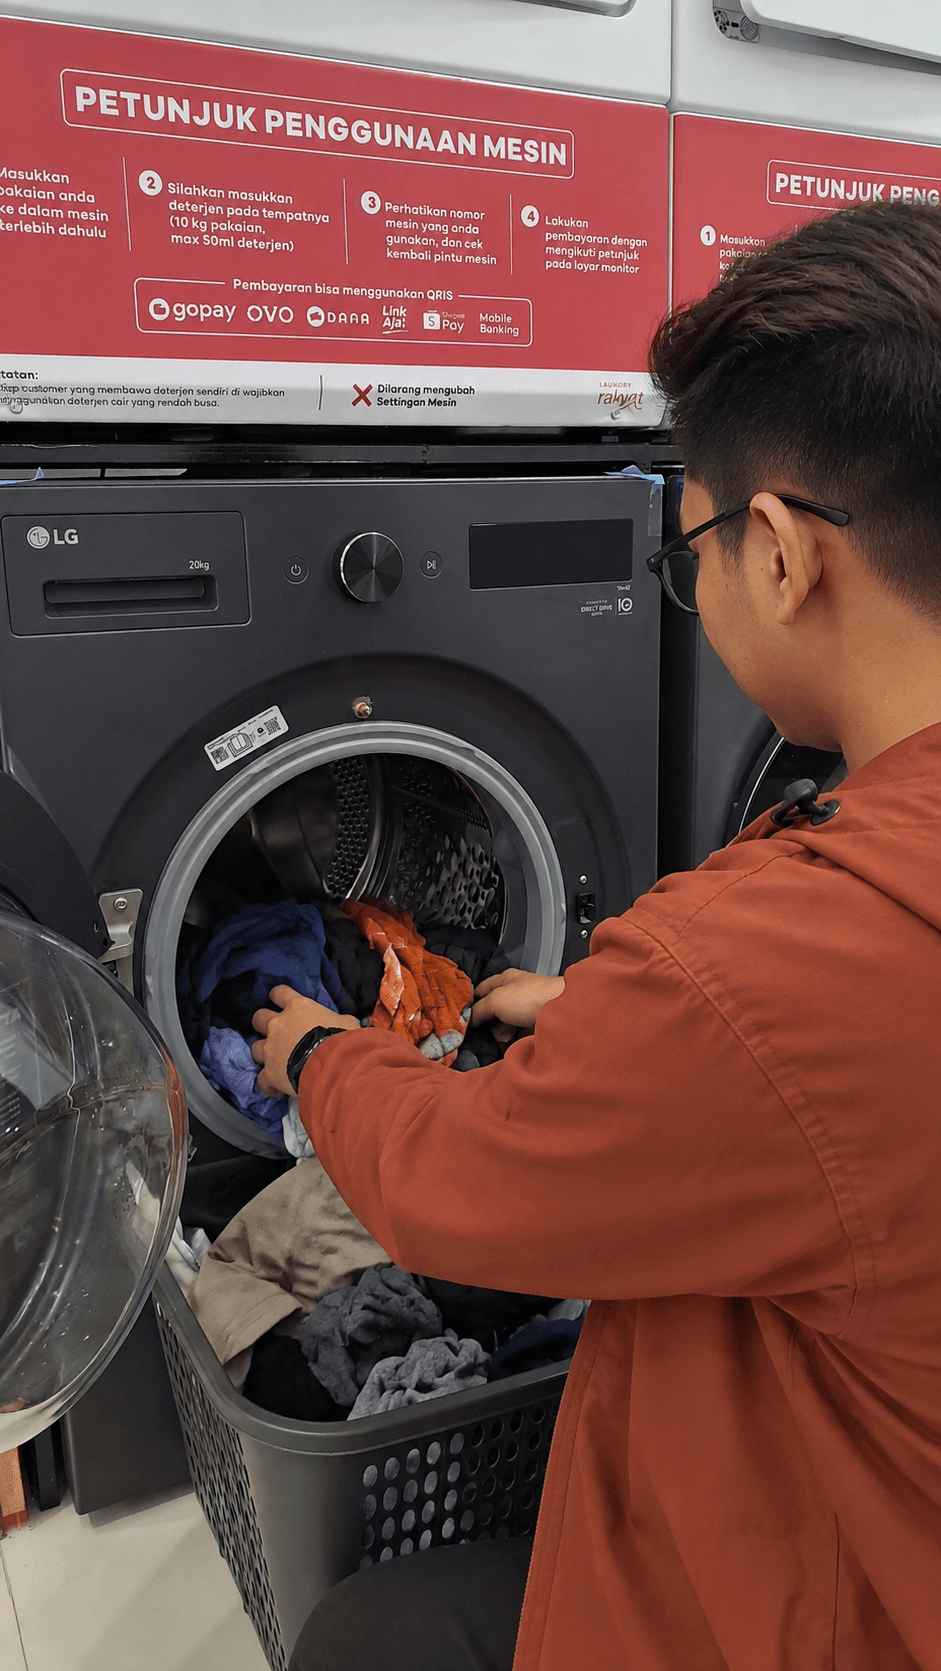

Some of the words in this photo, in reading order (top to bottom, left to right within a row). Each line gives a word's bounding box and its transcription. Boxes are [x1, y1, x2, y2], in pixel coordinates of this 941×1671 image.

[75, 86, 258, 132] PETUNJUK
[265, 109, 476, 156] PENGGUNAAN
[484, 134, 566, 166] MESIN
[146, 176, 156, 190] 2
[775, 172, 885, 202] PETUNJUK
[890, 185, 940, 206] PENG
[59, 190, 95, 203] anda
[168, 182, 224, 198] Silahkan
[228, 190, 293, 204] masukkan
[368, 196, 376, 209] 3
[18, 203, 64, 218] dalam
[68, 209, 109, 222] mesin
[168, 200, 224, 216] deterjen
[226, 205, 260, 218] pada
[262, 208, 330, 224] tempatnya
[385, 202, 447, 217] Perhatikan
[450, 210, 485, 220] nomor
[527, 210, 536, 222] 4
[170, 216, 188, 228] (10
[192, 218, 207, 232] kg
[211, 220, 266, 234] pakaian,
[386, 219, 418, 230] mesin
[421, 222, 448, 234] yang
[452, 224, 479, 234] anda
[546, 216, 588, 228] Lakukan
[58, 224, 106, 238] dahulu
[170, 234, 200, 244] max
[203, 234, 234, 248] 50ml
[237, 236, 294, 252] deterjen)
[386, 234, 438, 248] gunakan,
[442, 237, 462, 248] dan
[464, 239, 484, 250] cek
[546, 232, 610, 244] pembayaran
[611, 235, 648, 250] dengan
[386, 248, 431, 260] kembali
[434, 251, 462, 263] pintu
[465, 255, 496, 264] mesin
[546, 246, 596, 258] mengikuti
[598, 250, 640, 262] petunjuk
[546, 259, 572, 270] pada
[574, 260, 600, 272] layar
[602, 263, 640, 274] monitor
[233, 278, 312, 294] Pembayaran
[315, 283, 339, 295] bisa
[342, 288, 424, 300] menggunakan
[426, 290, 453, 301] QRIS
[173, 302, 236, 322] gopay
[247, 304, 294, 324] OVO
[382, 305, 406, 317] Link
[480, 312, 512, 323] Mobile
[442, 320, 464, 334] Pay
[480, 324, 518, 337] Banking
[70, 386, 95, 396] yang
[98, 386, 150, 394] membawa
[196, 387, 228, 396] sendiri
[231, 387, 240, 396] di
[242, 388, 285, 398] wajibkan
[378, 384, 420, 396] Dilarang
[423, 386, 475, 396] mengubah
[111, 397, 130, 406] cair
[131, 400, 154, 408] yang
[158, 398, 192, 406] rendah
[194, 399, 220, 407] busa.
[377, 397, 426, 408] Settingan
[428, 398, 456, 406] Mesin
[598, 390, 644, 410] rakyat
[53, 528, 79, 546] LG
[188, 560, 210, 572] 20kg
